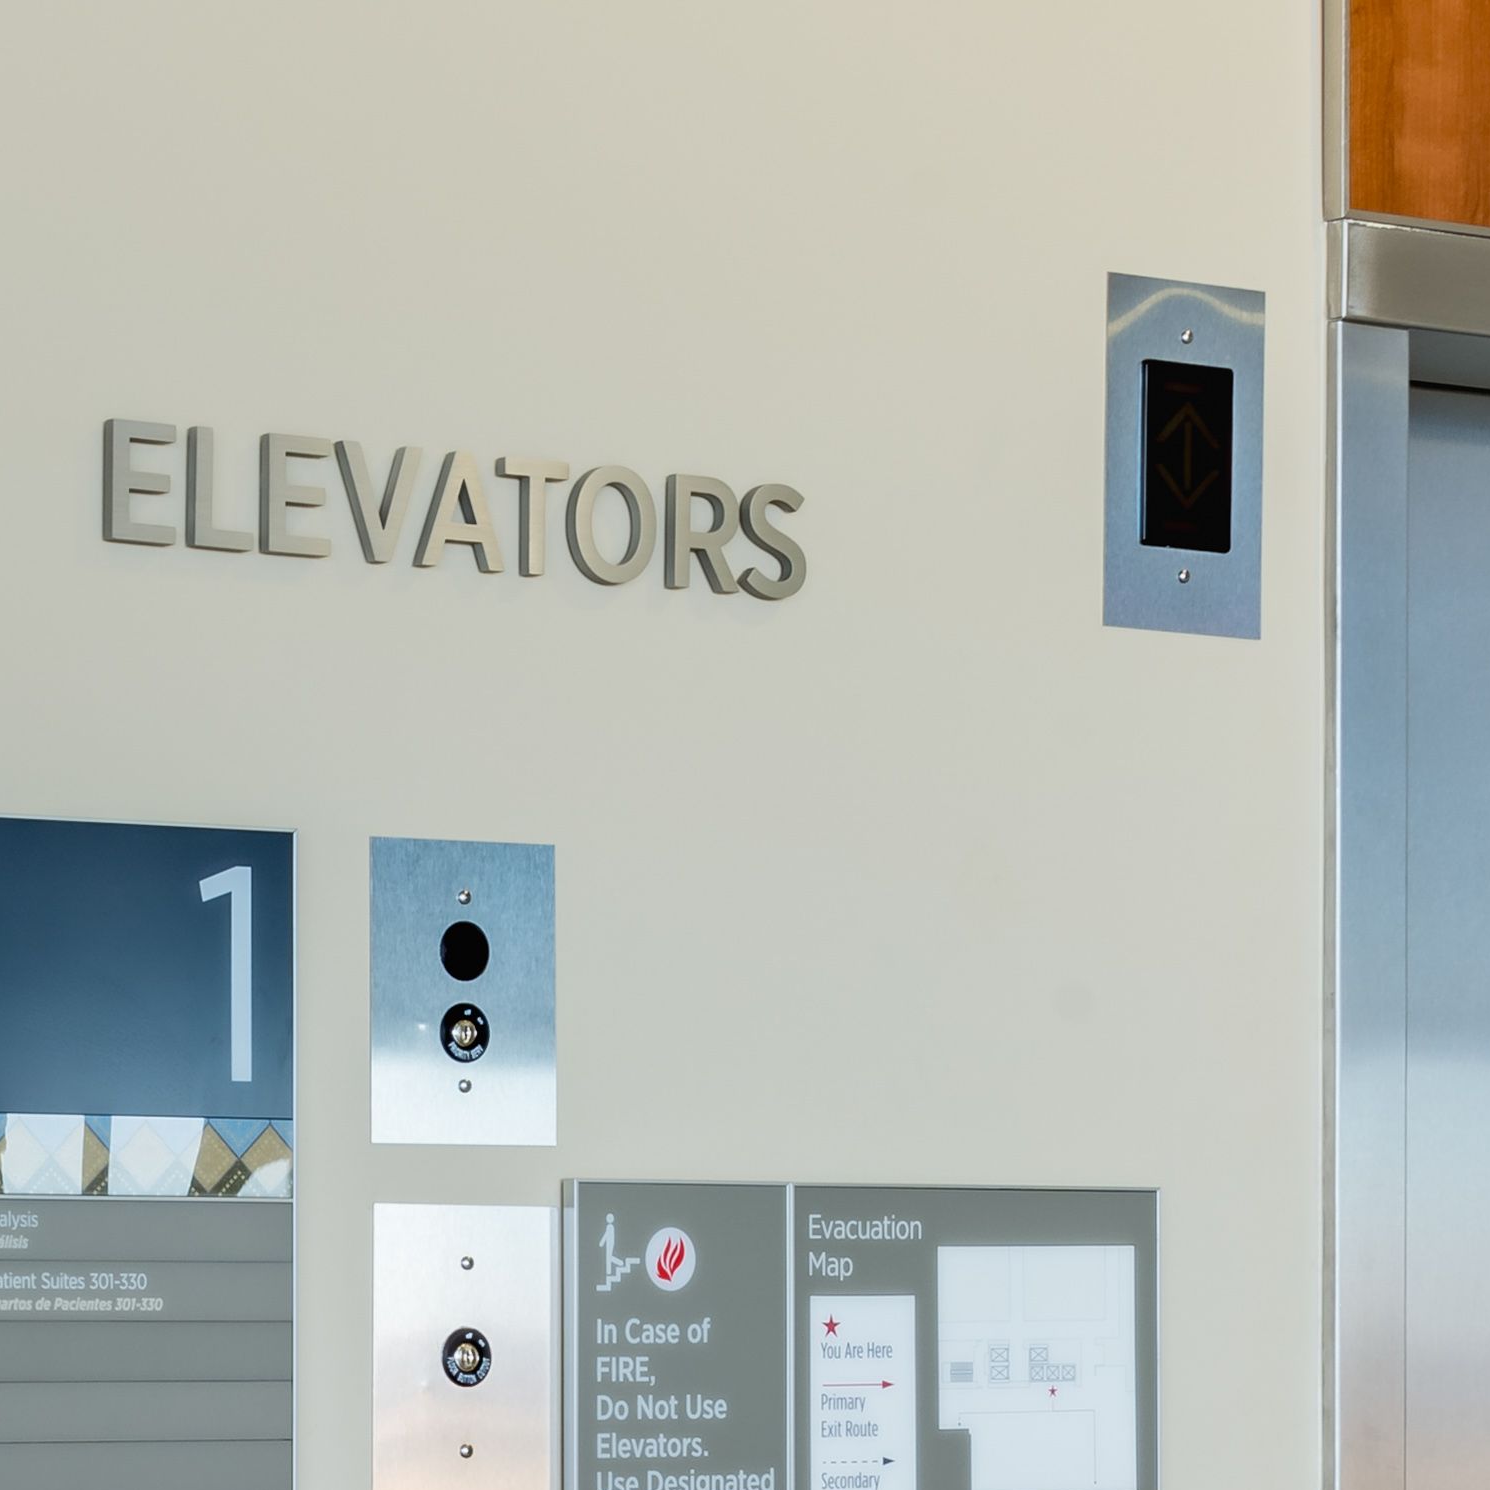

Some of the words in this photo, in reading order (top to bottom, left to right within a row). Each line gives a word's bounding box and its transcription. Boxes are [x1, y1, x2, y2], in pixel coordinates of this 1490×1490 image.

[102, 418, 808, 601] ELEVATORS
[198, 865, 252, 1082] 1
[809, 1214, 921, 1239] Evacuation
[809, 1252, 853, 1281] Map
[41, 1272, 85, 1289] Suites
[90, 1273, 147, 1290] 301-330
[35, 1297, 51, 1310] de
[54, 1297, 112, 1311] Pacientes
[115, 1298, 163, 1311] 301-330
[597, 1319, 617, 1343] In
[625, 1318, 680, 1344] Case
[688, 1317, 710, 1343] of
[821, 1343, 841, 1359] You
[845, 1342, 863, 1359] Are
[867, 1342, 892, 1358] Here
[597, 1357, 655, 1386] FIRE,
[597, 1395, 629, 1420] Do
[637, 1395, 678, 1419] Not
[686, 1394, 727, 1419] Use
[821, 1393, 865, 1412] Primary
[821, 1421, 842, 1438] Exit
[846, 1420, 878, 1437] Route
[597, 1433, 708, 1458] Elevators.
[821, 1472, 880, 1490] Secondary
